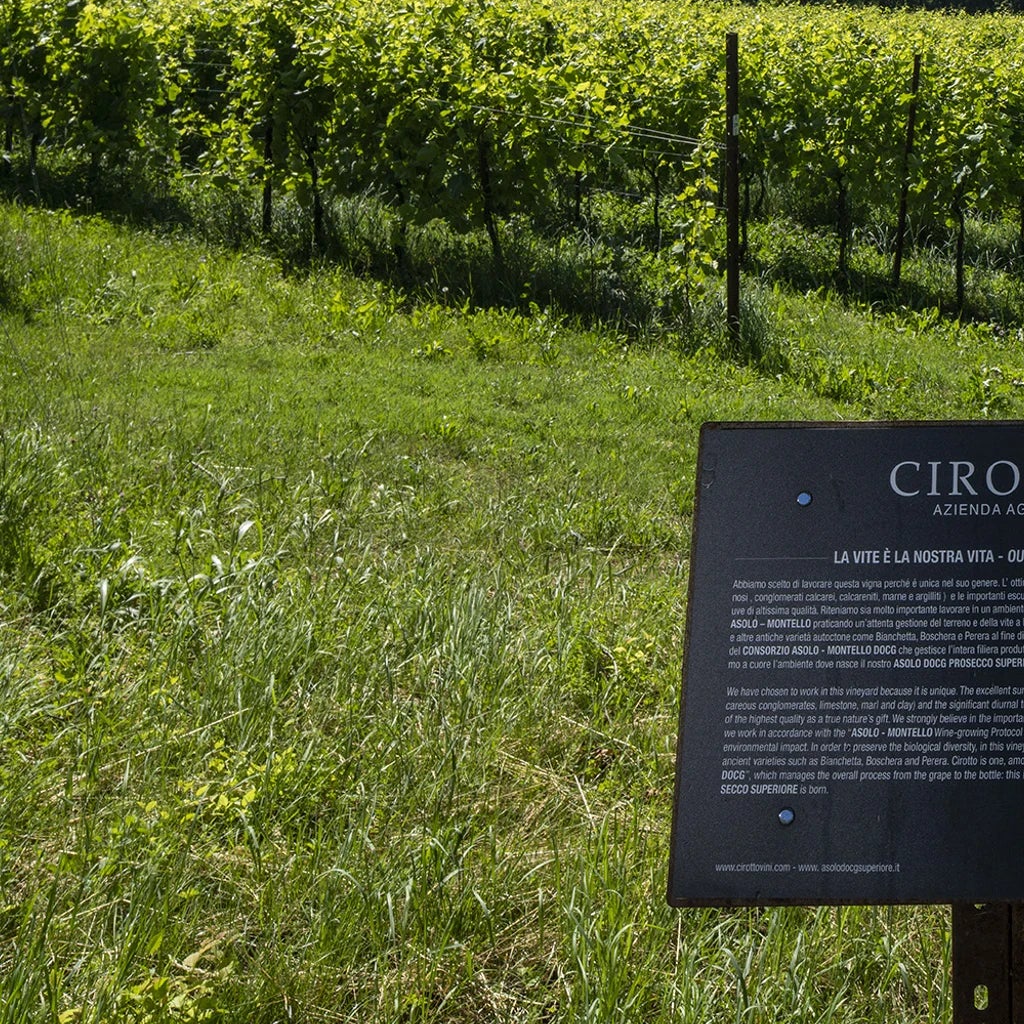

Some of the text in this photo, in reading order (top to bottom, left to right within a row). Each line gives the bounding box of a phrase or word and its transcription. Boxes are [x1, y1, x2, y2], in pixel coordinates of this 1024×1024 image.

[932, 503, 1002, 516] AZIENDA
[833, 550, 850, 564] LA
[852, 550, 881, 564] VITE
[883, 547, 892, 564] È
[894, 550, 911, 564] LA
[913, 549, 964, 564] NOSTRA
[966, 549, 995, 563] VITA
[732, 578, 766, 589] Abbiamo
[767, 578, 791, 588] scelto
[801, 577, 832, 588] lavorare
[833, 577, 859, 590] questa
[861, 577, 882, 590] vigna
[918, 577, 939, 587] unica
[753, 591, 803, 604] conglomerati
[882, 593, 906, 601] marne
[915, 590, 941, 603] argilliti
[966, 589, 1005, 602] importanti
[755, 604, 790, 615] altissima
[820, 603, 858, 614] Riteniamo
[873, 603, 894, 614] molto
[896, 603, 937, 616] importante
[938, 602, 970, 613] lavorare
[730, 618, 758, 629] ASOLO
[766, 617, 811, 628] MONTELLO
[812, 617, 853, 630] praticando
[894, 616, 928, 630] gestione
[943, 616, 971, 627] terreno
[979, 616, 998, 627] della
[755, 631, 784, 641] antiche
[812, 630, 851, 641] autoctone
[919, 629, 956, 640] Boschera
[964, 629, 989, 640] Perera
[742, 644, 790, 655] CONSORZIO
[791, 644, 819, 655] ASOLO
[827, 643, 871, 655] MONTELLO
[873, 643, 896, 654] DOCG
[914, 643, 946, 656] gestisce
[976, 642, 998, 653] filiera
[867, 657, 891, 668] nostro
[893, 657, 921, 668] ASOLO
[923, 657, 946, 668] DOCG
[948, 657, 993, 667] PROSECCO
[760, 685, 789, 696] chosen
[844, 684, 879, 698] vineyard
[879, 684, 913, 695] because
[975, 683, 1012, 694] excellent
[724, 702, 757, 710] careous
[948, 697, 990, 711] significant
[991, 697, 1019, 708] diurnal
[748, 713, 778, 726] highest
[778, 712, 806, 726] quality
[905, 711, 938, 725] strongly
[938, 711, 968, 722] believe
[767, 726, 813, 738] accordance
[886, 725, 933, 737] MONTELLO
[990, 724, 1023, 736] Protocol
[722, 741, 779, 752] environmental
[852, 743, 888, 754] preserve
[903, 739, 941, 753] biological
[721, 756, 751, 767] ancient
[751, 756, 787, 767] varieties
[865, 755, 903, 765] Boschera
[951, 754, 978, 765] Cirotto
[778, 772, 816, 782] manages
[831, 768, 858, 780] overall
[859, 771, 891, 782] process
[719, 783, 799, 794] SECCO SUPERIORE
[715, 862, 791, 872] www.cirottovini.com
[798, 864, 819, 872] www.
[820, 862, 900, 874] asolodocgsuperiore.it
